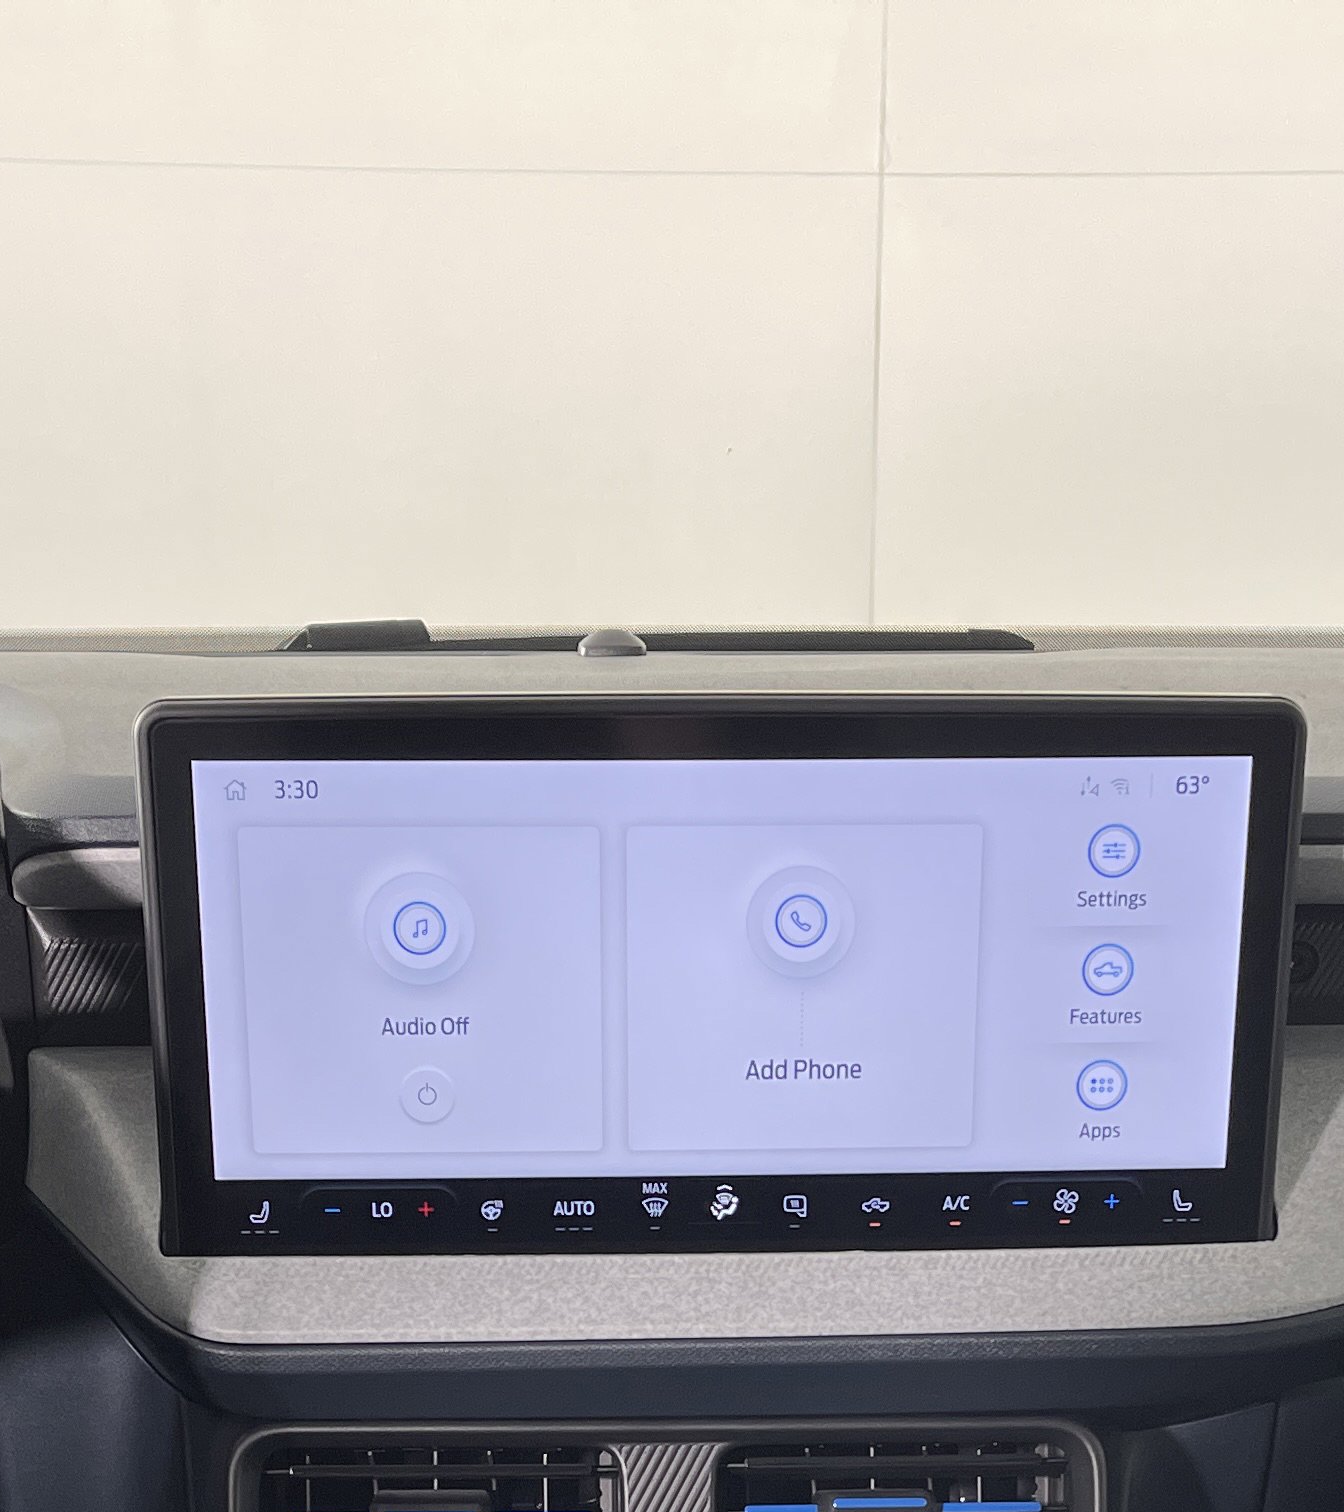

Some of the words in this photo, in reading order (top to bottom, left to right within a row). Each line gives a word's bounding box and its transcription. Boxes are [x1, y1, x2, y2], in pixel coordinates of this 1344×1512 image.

[274, 780, 319, 799] 3:30
[1176, 776, 1210, 796] 63°
[1077, 891, 1147, 909] Settings
[1070, 1008, 1142, 1025] Features
[381, 1017, 437, 1036] Audio
[440, 1017, 469, 1036] Off
[746, 1060, 788, 1080] Add
[793, 1059, 862, 1080] Phone
[1079, 1123, 1121, 1141] Apps
[642, 1183, 668, 1194] MAX
[371, 1202, 393, 1218] LO
[554, 1201, 595, 1216] AUTO
[942, 1195, 970, 1211] A/C
